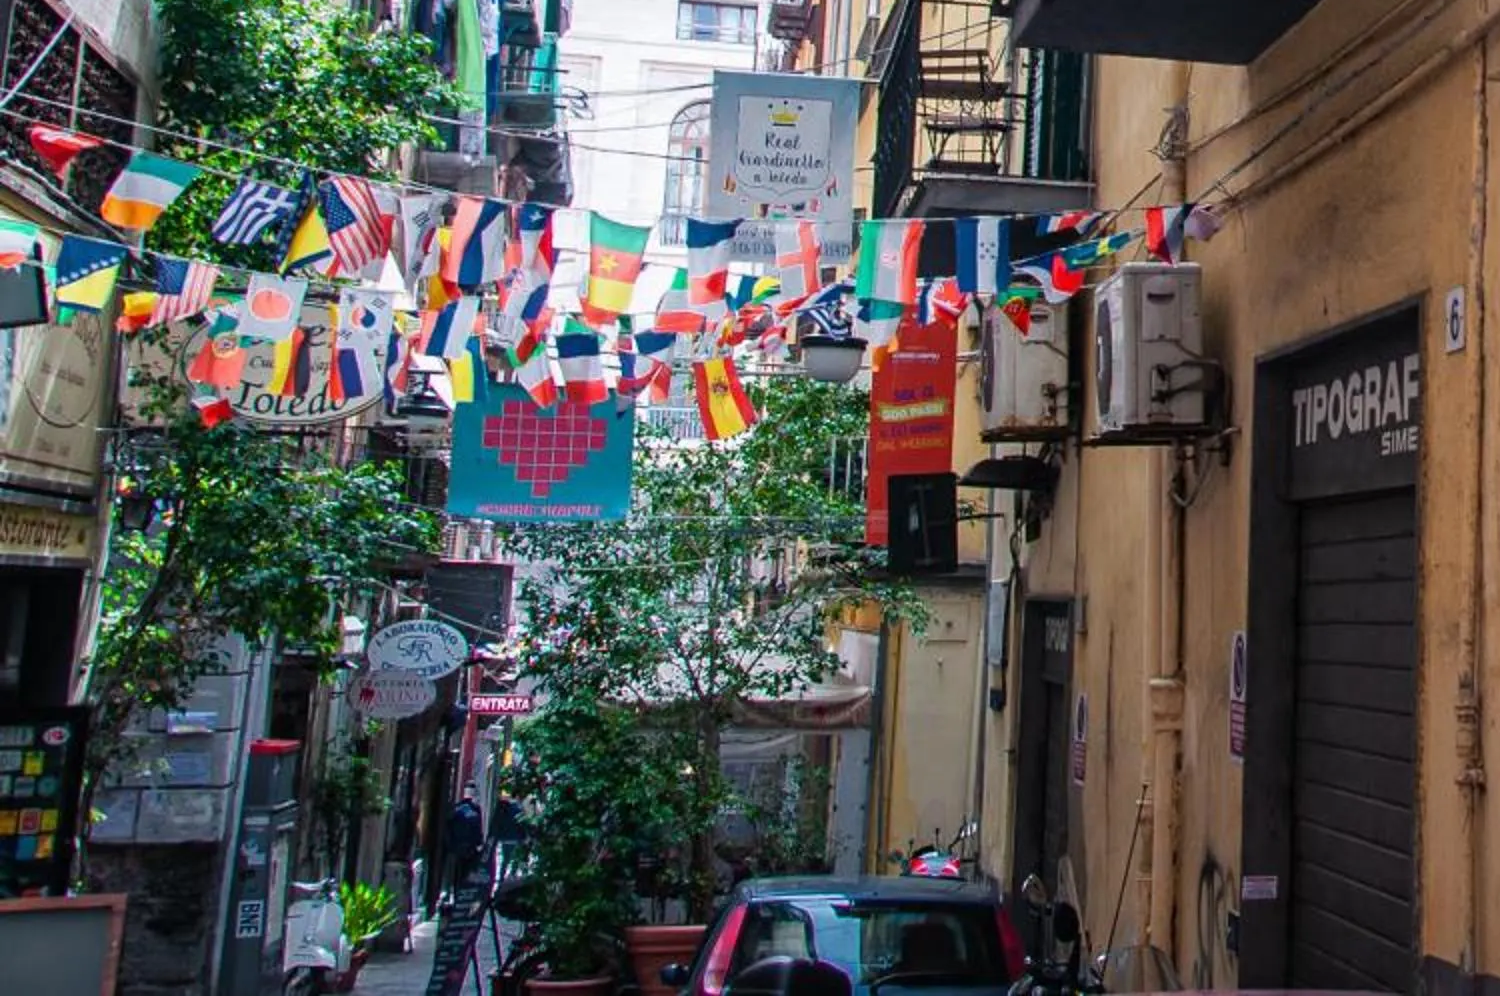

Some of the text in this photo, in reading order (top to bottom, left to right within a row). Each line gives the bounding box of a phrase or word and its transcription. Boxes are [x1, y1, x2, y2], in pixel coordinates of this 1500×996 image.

[765, 131, 802, 150] Real
[1450, 297, 1461, 341] 6
[1293, 354, 1420, 448] TIPOGRAF
[1381, 425, 1419, 456] SIME
[471, 696, 530, 712] ENTRATA
